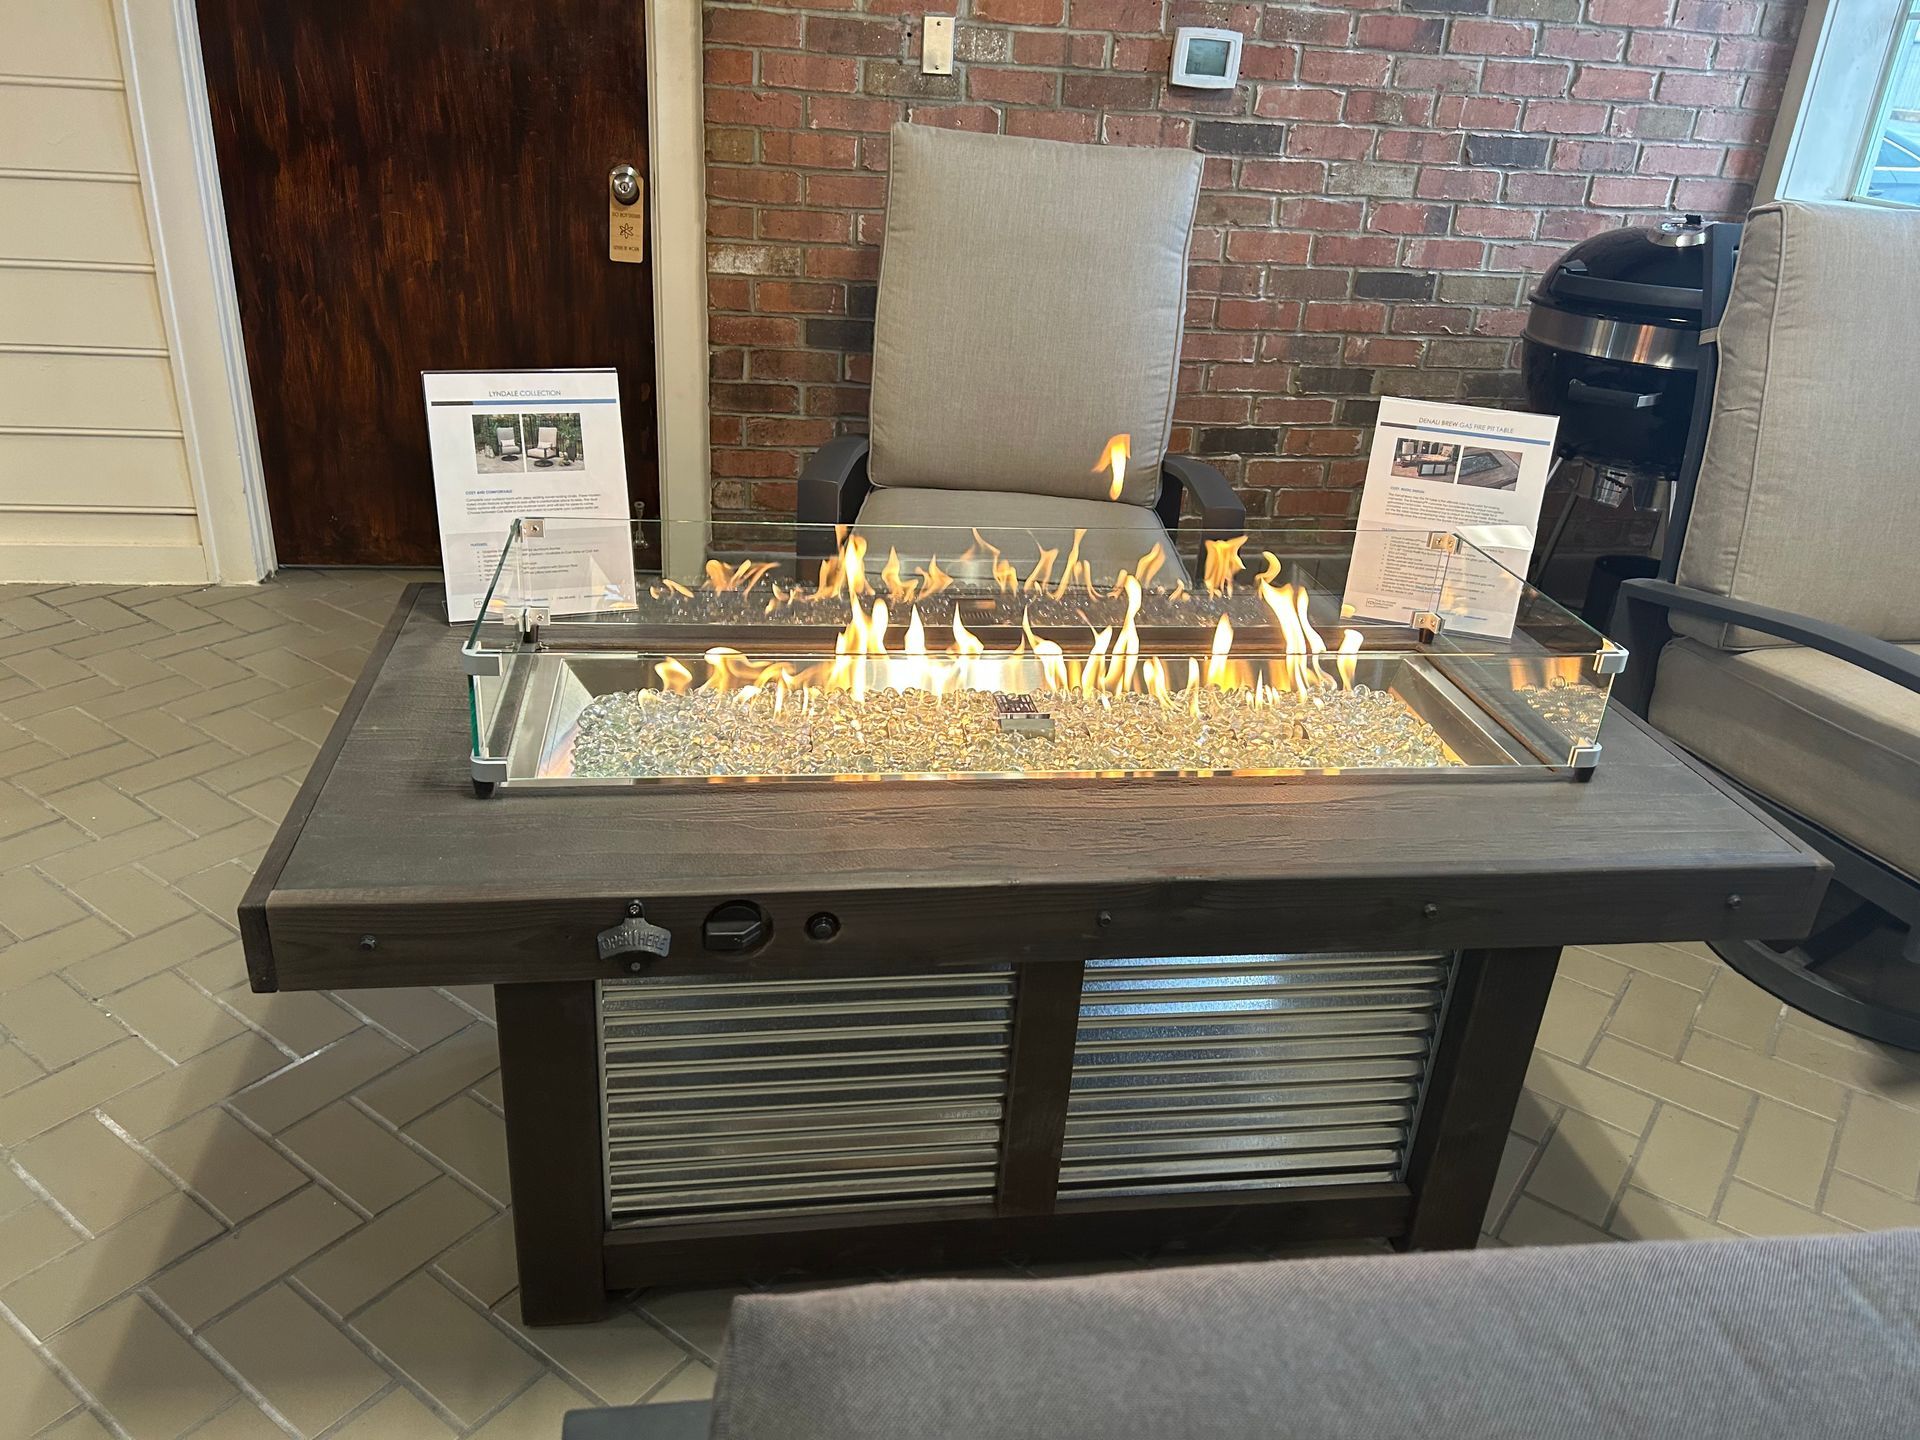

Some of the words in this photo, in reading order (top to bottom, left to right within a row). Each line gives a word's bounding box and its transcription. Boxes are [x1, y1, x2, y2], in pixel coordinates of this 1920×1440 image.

[488, 389, 519, 397] LYNDALE
[519, 389, 561, 397] COLLECTION
[1441, 420, 1459, 428] BREW
[1473, 423, 1486, 431] FIRE
[1495, 426, 1514, 434] TABLE
[601, 930, 634, 950] OPEN
[638, 931, 669, 951] HERE
